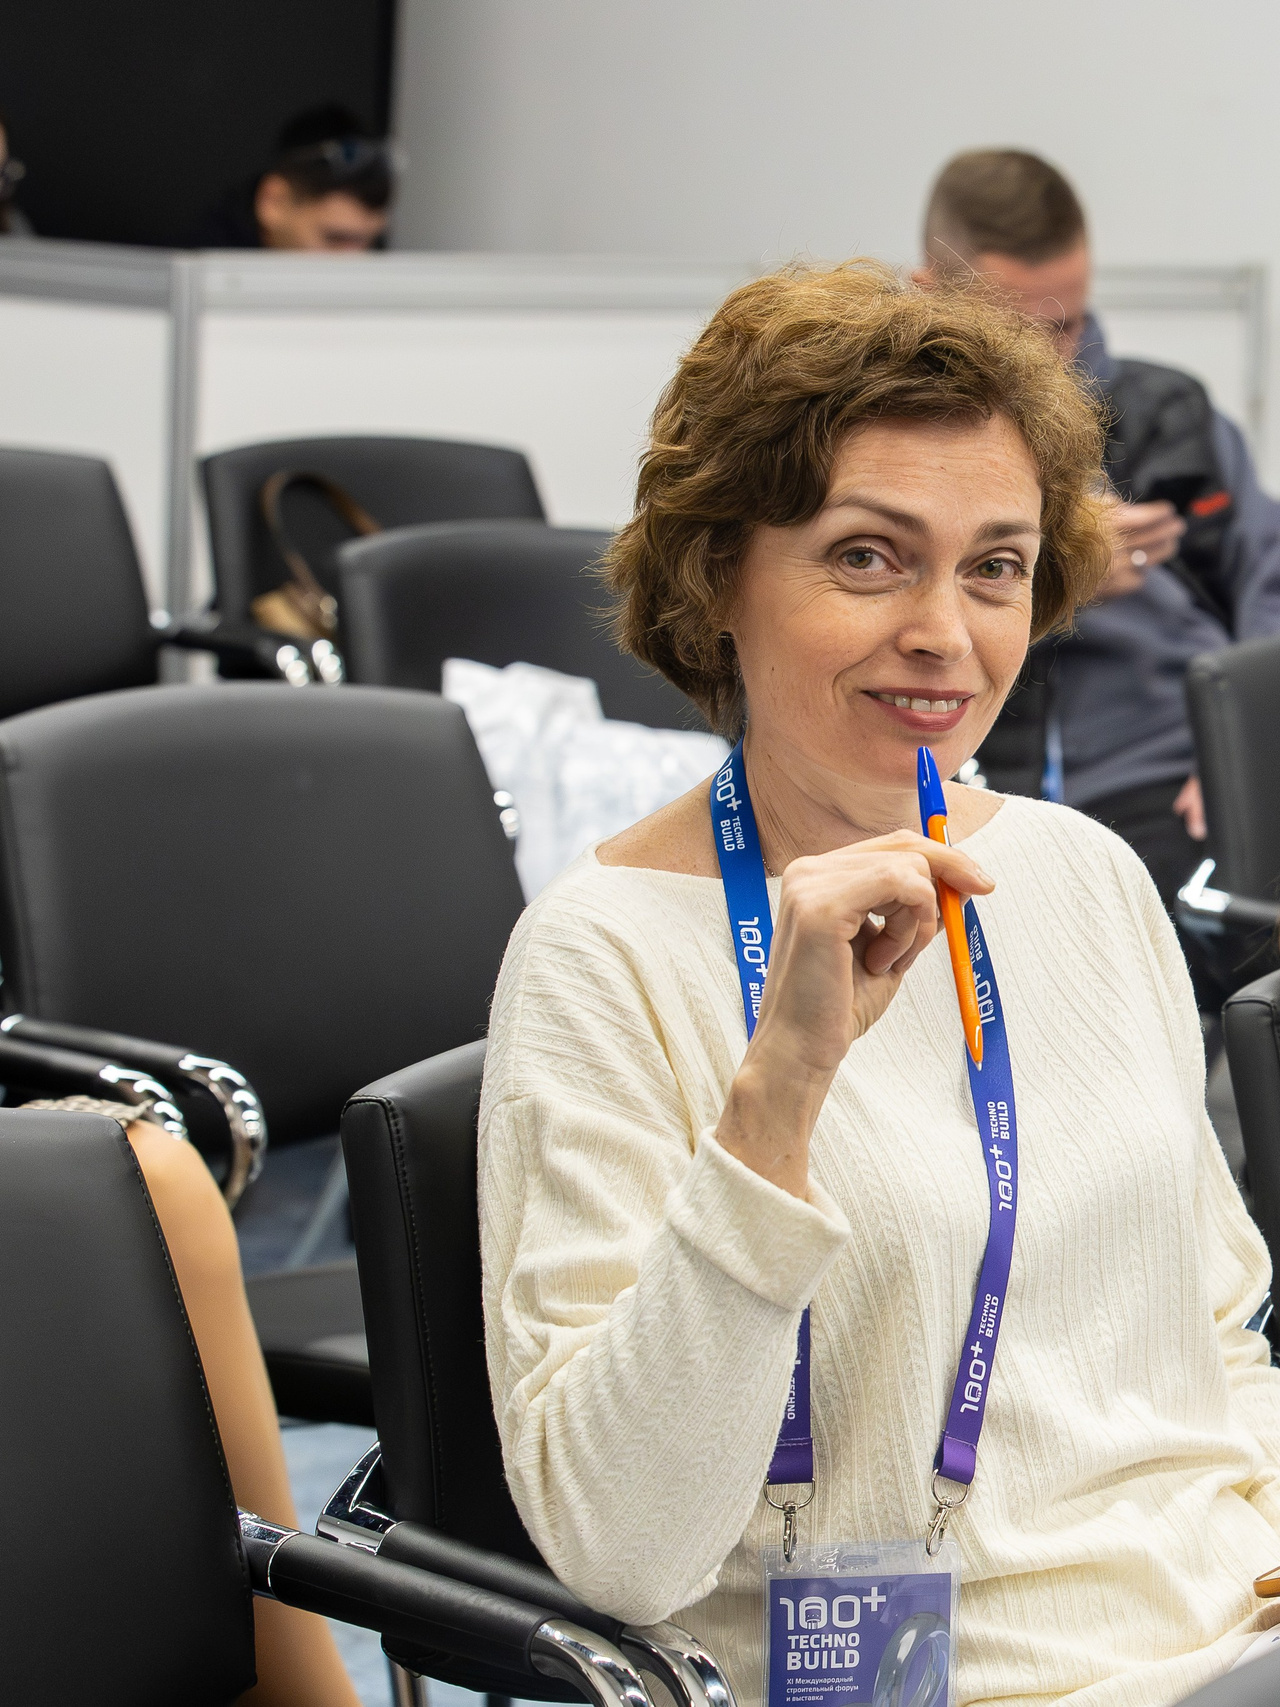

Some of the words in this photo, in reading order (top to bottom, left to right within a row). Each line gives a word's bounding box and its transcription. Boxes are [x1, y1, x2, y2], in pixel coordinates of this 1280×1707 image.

[716, 758, 742, 811] 100+
[720, 819, 735, 852] BUILD
[732, 815, 746, 850] TECHNO
[738, 916, 768, 977] 100+
[973, 924, 983, 961] BUILD
[987, 1101, 999, 1139] TECHNO
[997, 1101, 1010, 1140] BUILD
[989, 1144, 1012, 1211] 100+
[978, 1293, 992, 1335] TECHNO
[985, 1296, 999, 1338] BUILD
[960, 1341, 987, 1413] 100+
[779, 1586, 887, 1630] 100+
[787, 1632, 860, 1649] TECHNO
[786, 1650, 860, 1671] BUILD
[786, 1685, 834, 1694] строительный
[835, 1684, 859, 1692] форум
[795, 1676, 854, 1685] Международный
